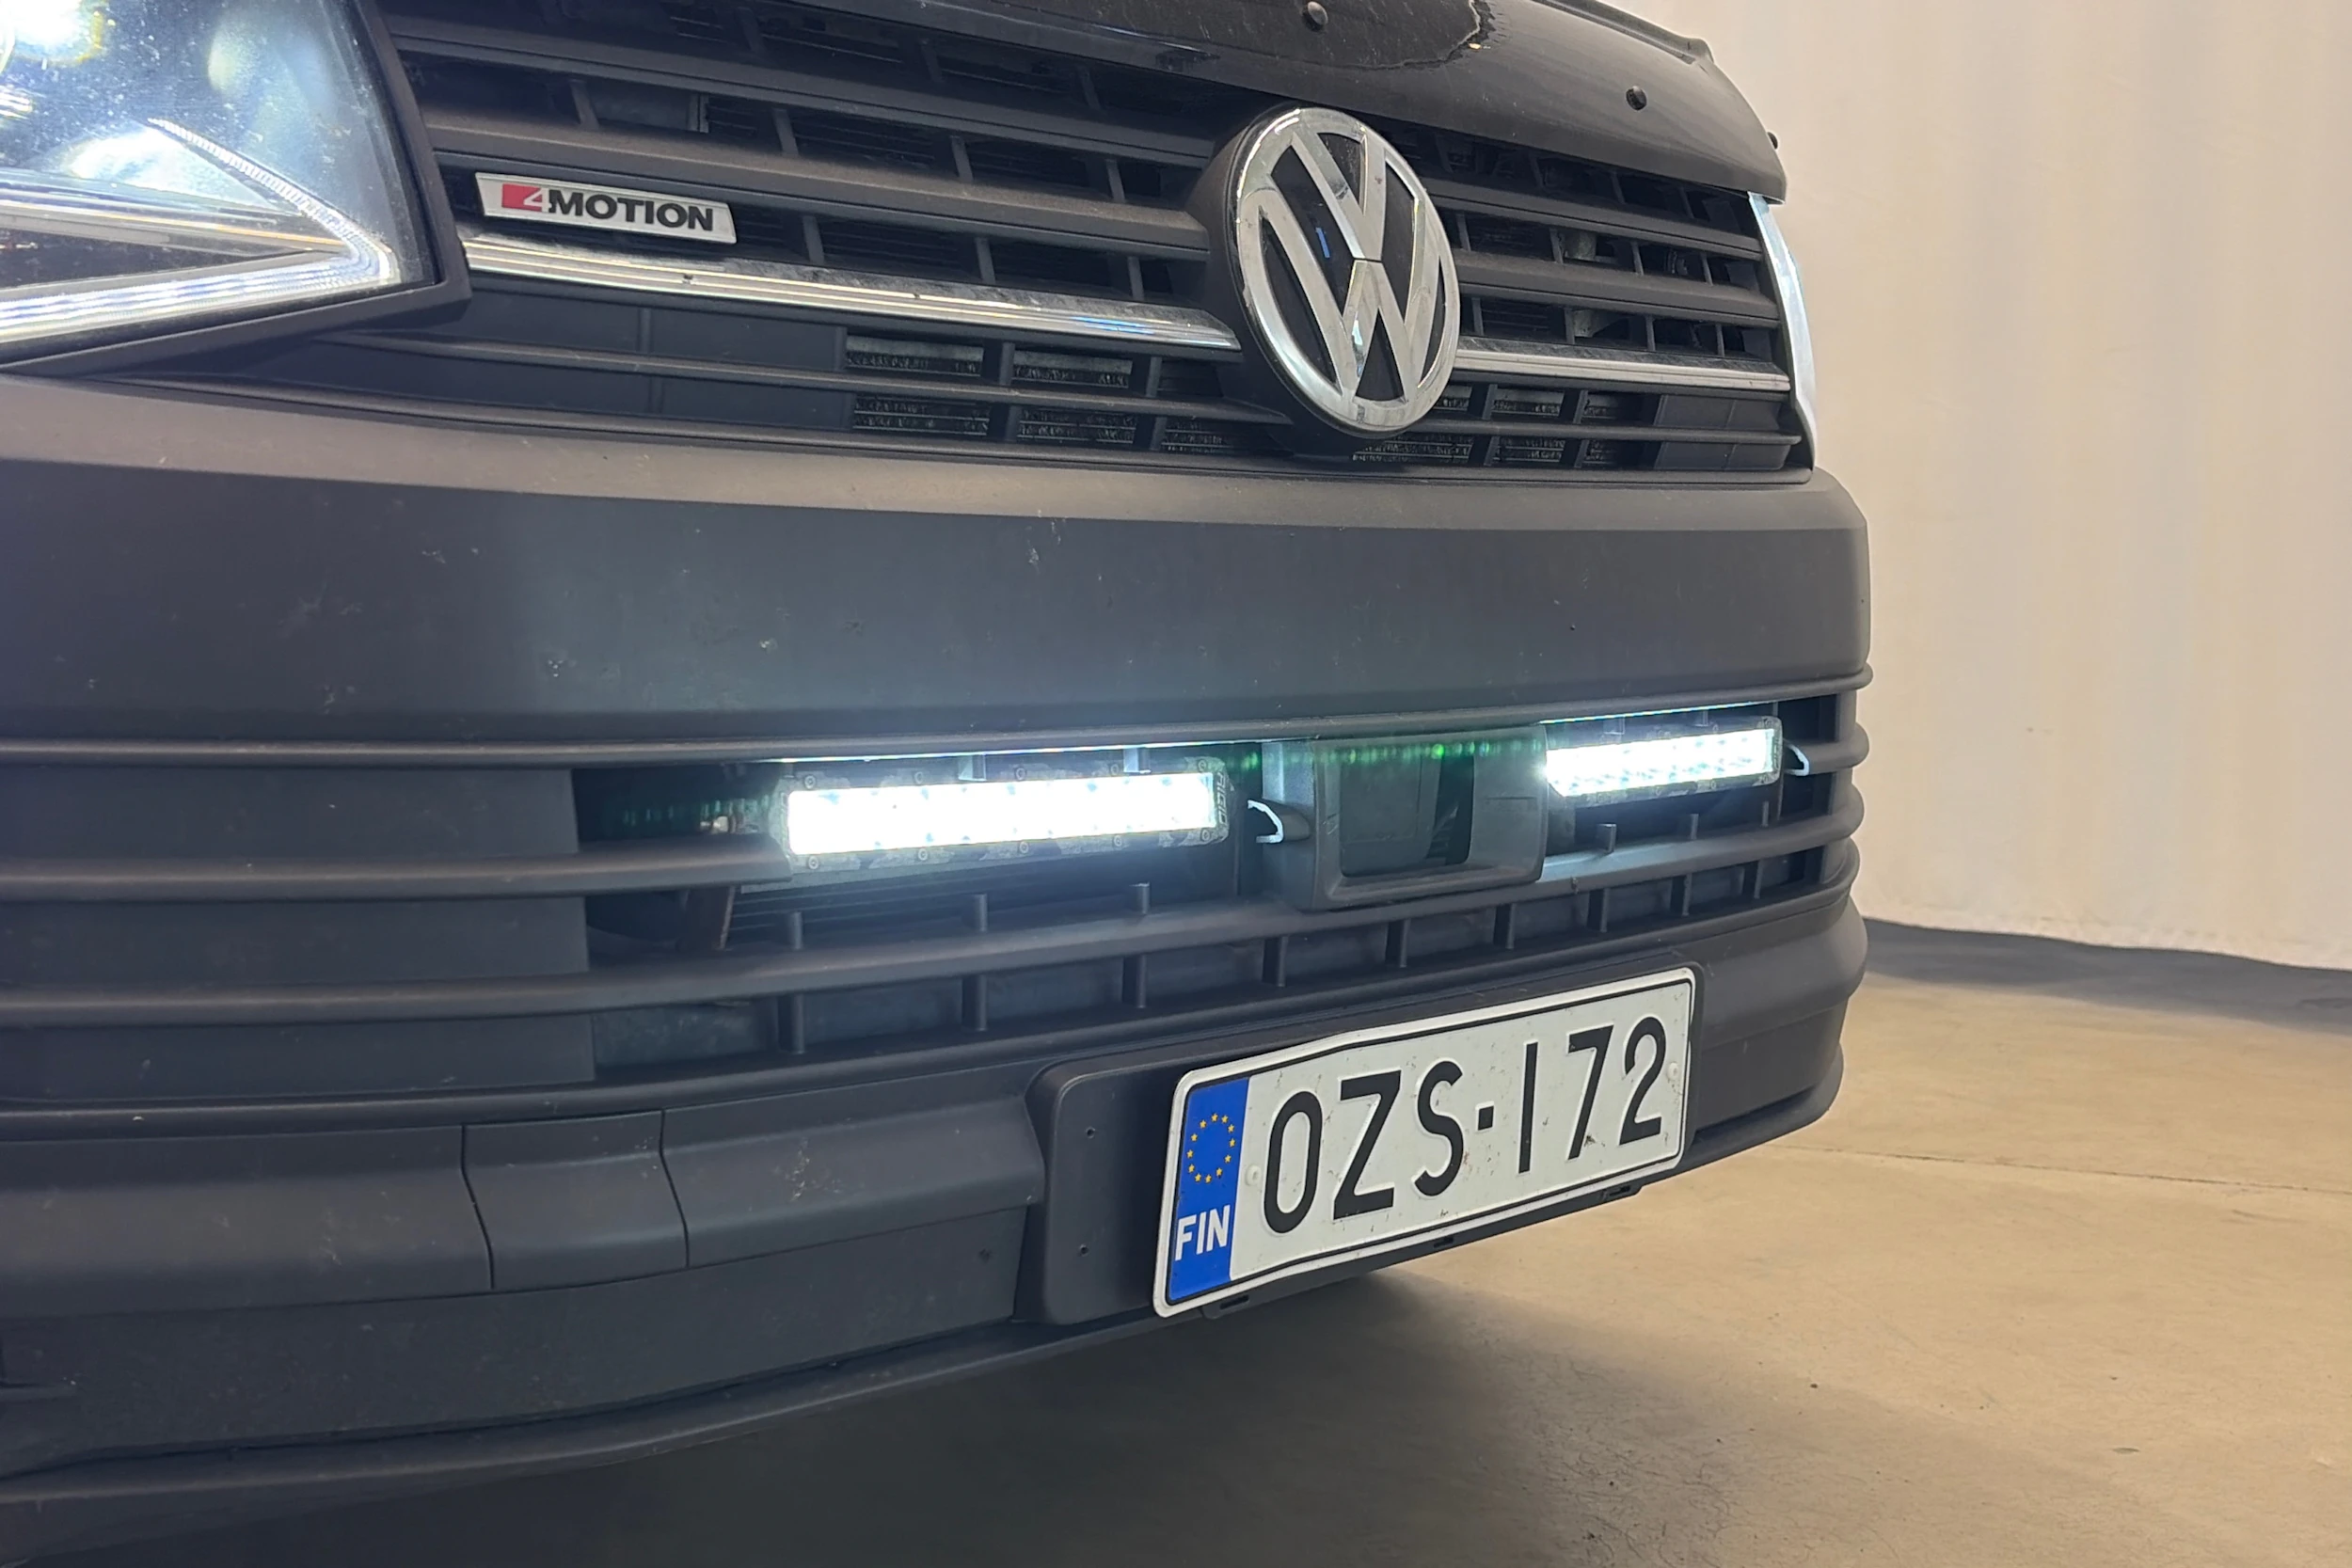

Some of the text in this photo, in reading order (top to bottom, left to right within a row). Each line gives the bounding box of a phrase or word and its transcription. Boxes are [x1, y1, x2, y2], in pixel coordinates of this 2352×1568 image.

[520, 183, 714, 231] 4MOTION
[1263, 1016, 1667, 1234] OZS-172
[1174, 1204, 1232, 1261] FIN
